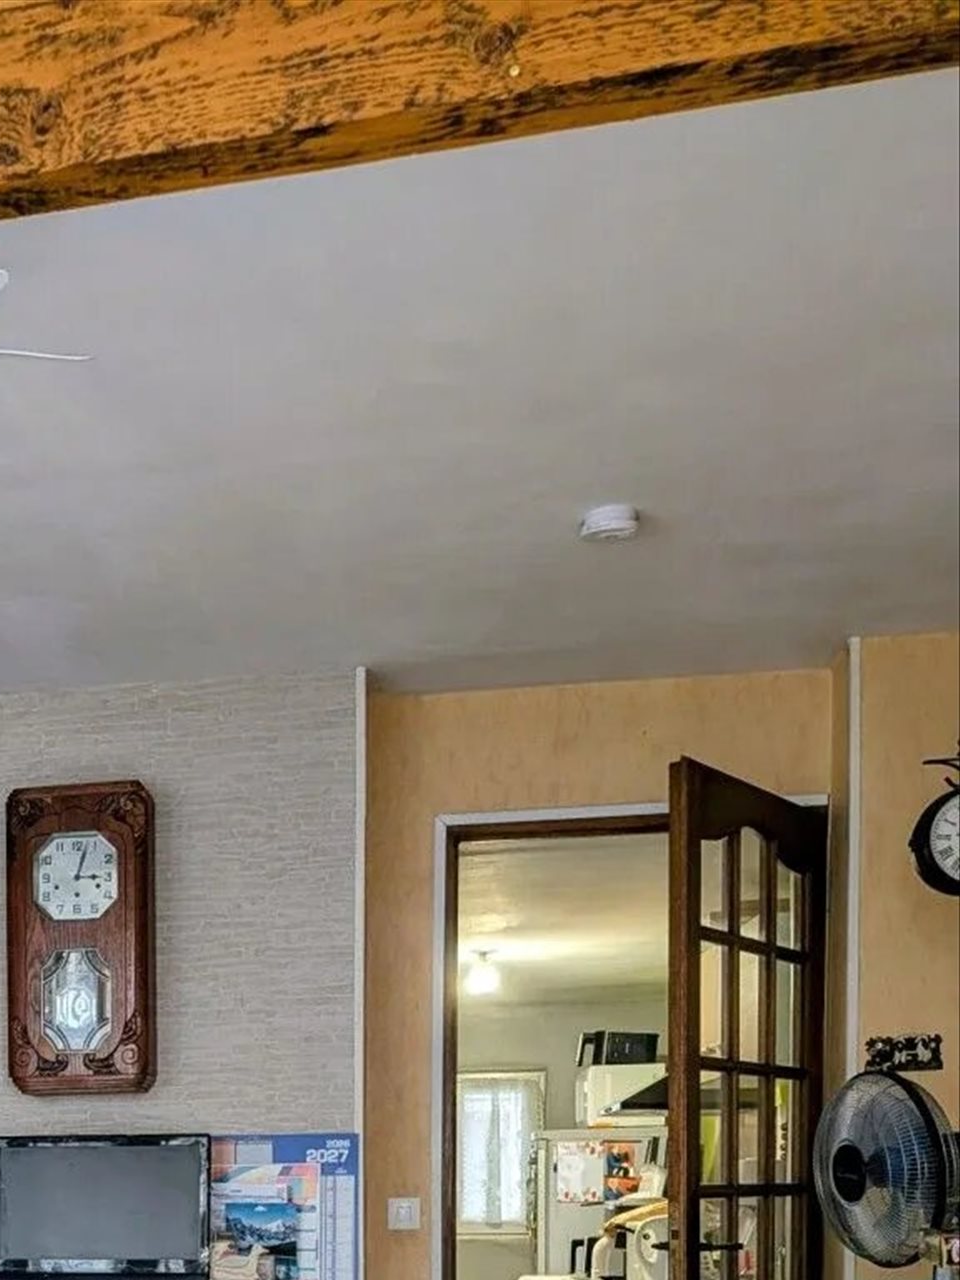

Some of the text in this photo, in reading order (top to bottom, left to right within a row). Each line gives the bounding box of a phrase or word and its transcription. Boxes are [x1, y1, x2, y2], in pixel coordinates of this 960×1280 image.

[55, 842, 64, 852] 11
[71, 841, 84, 852] 12
[40, 855, 52, 866] 10
[104, 854, 113, 864] 2
[42, 873, 51, 884] 9
[103, 872, 112, 882] 3
[42, 892, 51, 902] 8
[104, 891, 114, 900] 4
[56, 904, 64, 914] 7
[72, 904, 82, 914] 6
[90, 903, 99, 914] 5
[306, 1149, 349, 1163] 2027
